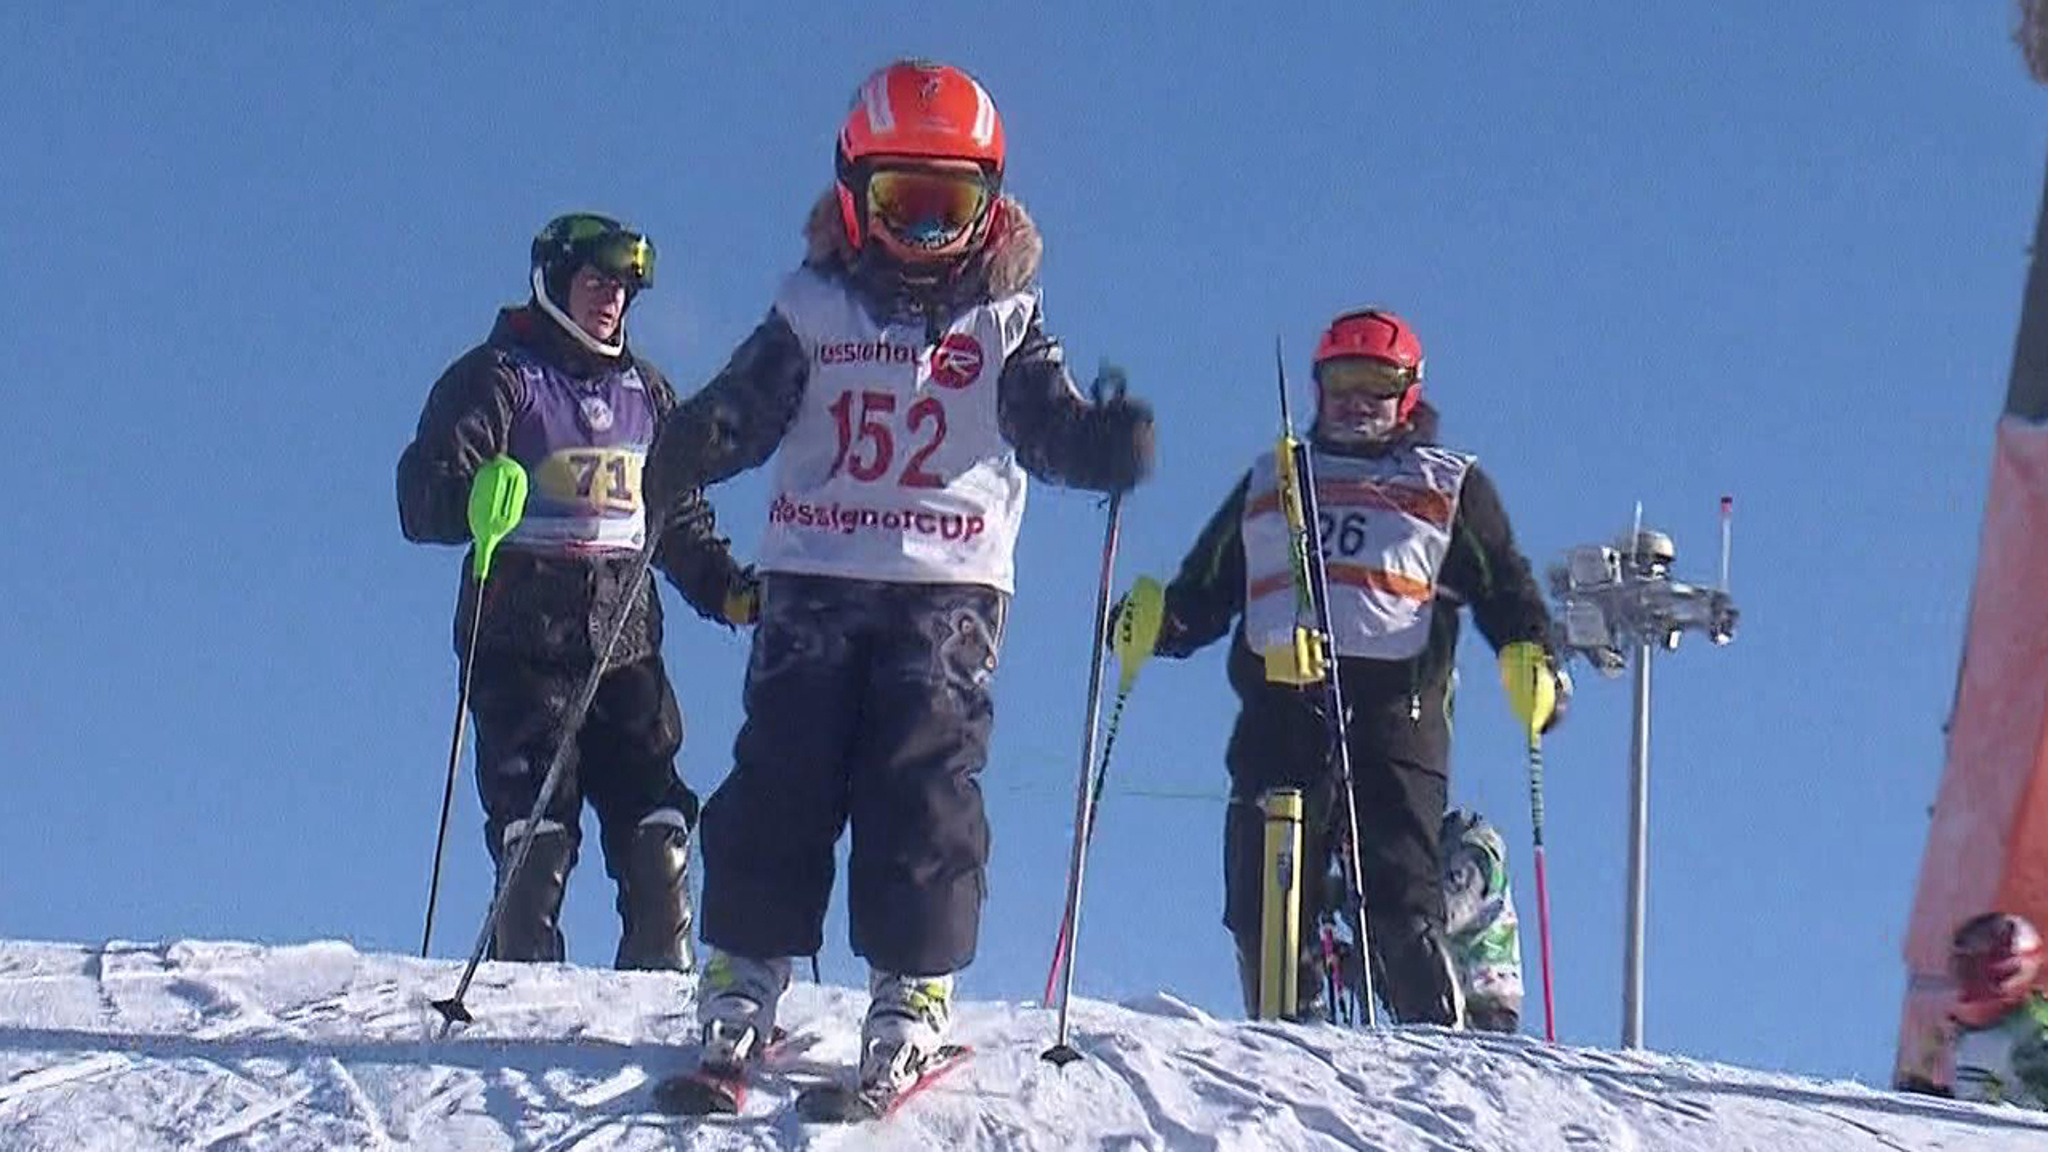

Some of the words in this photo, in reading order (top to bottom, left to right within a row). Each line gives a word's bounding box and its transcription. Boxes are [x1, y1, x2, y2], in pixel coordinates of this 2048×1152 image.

[828, 389, 948, 489] 152
[569, 455, 632, 500] 71
[1319, 511, 1366, 557] 26
